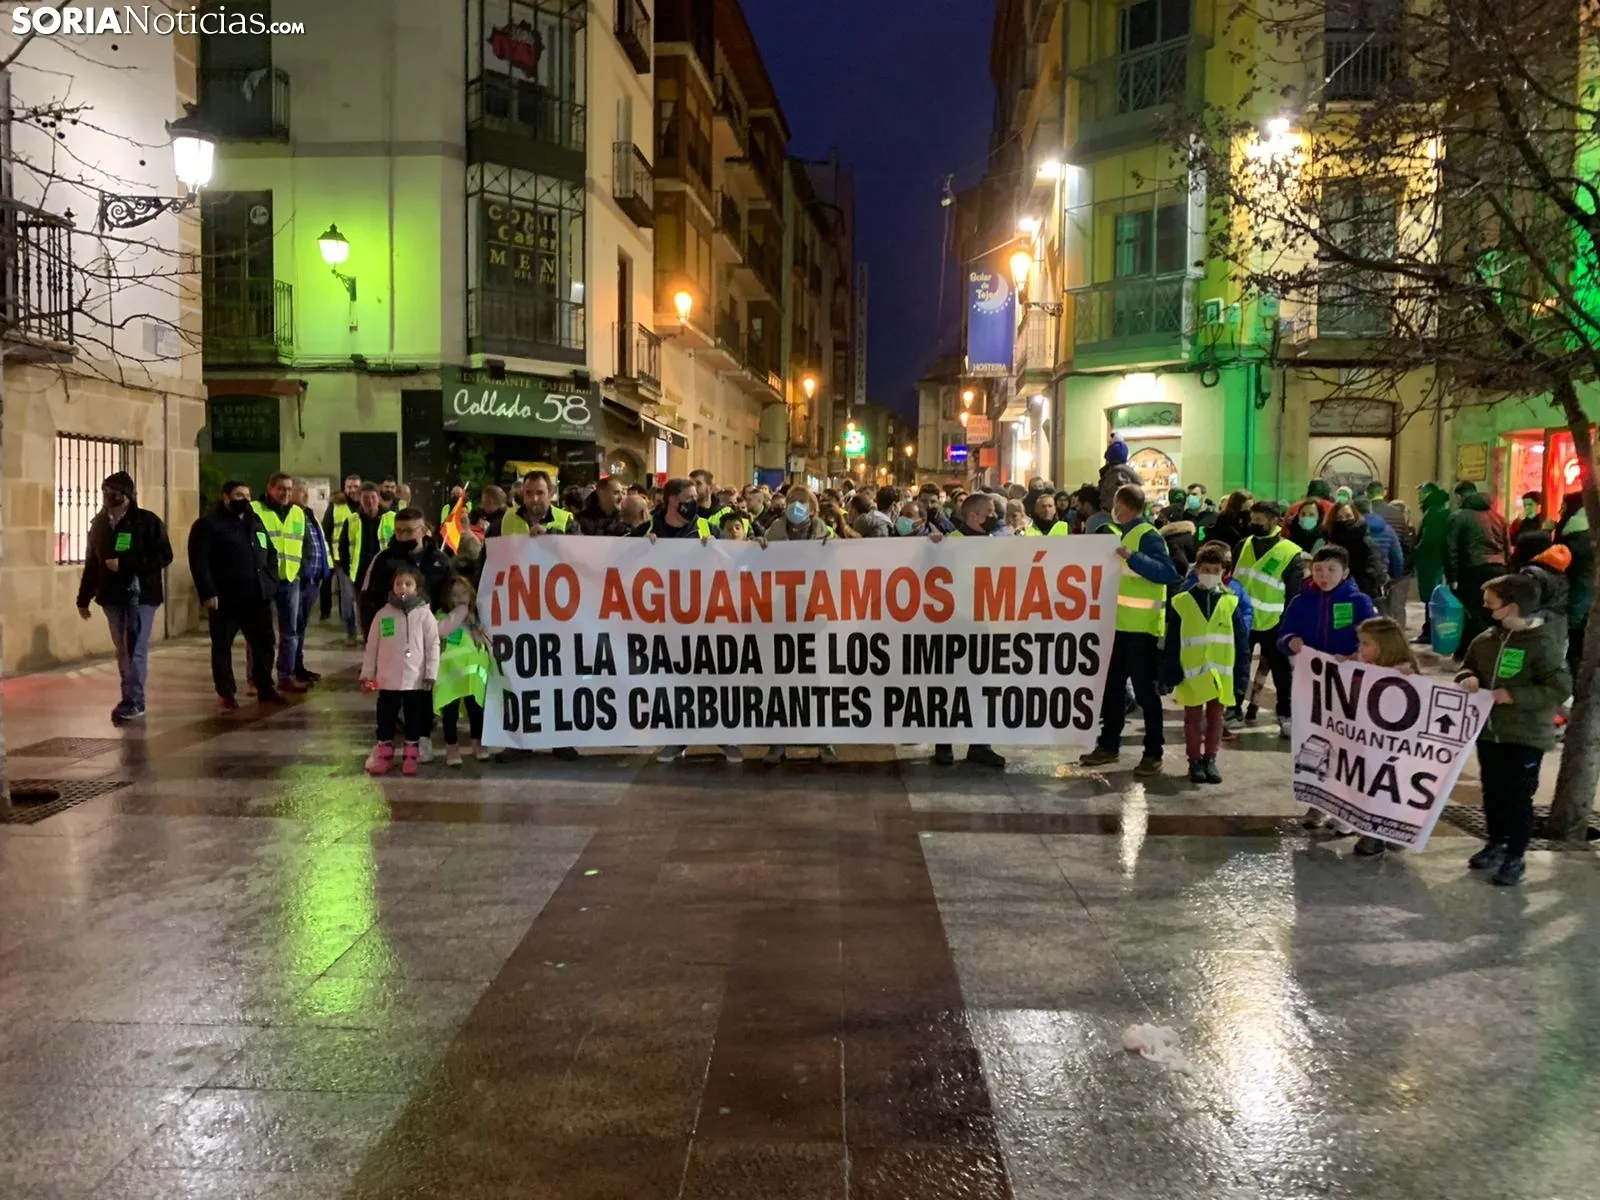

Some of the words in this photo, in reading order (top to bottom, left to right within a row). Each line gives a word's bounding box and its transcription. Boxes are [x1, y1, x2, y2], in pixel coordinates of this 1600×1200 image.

[453, 388, 532, 418] Collado
[535, 393, 591, 425] 58
[599, 566, 955, 624] AGUANTAMOS
[973, 551, 1103, 622] MÁS!
[492, 633, 562, 678] POR
[574, 632, 617, 676] LA
[627, 633, 763, 675] BAJADA
[773, 633, 816, 675] DE
[828, 632, 890, 676] LOS
[902, 632, 1100, 677] IMPUESTOS
[503, 687, 541, 734] DE
[554, 687, 617, 731] LOS
[628, 685, 872, 730] CARBURANTES
[884, 686, 973, 728] PARA
[982, 686, 1094, 731] TODOS
[1335, 748, 1438, 811] MÁS
